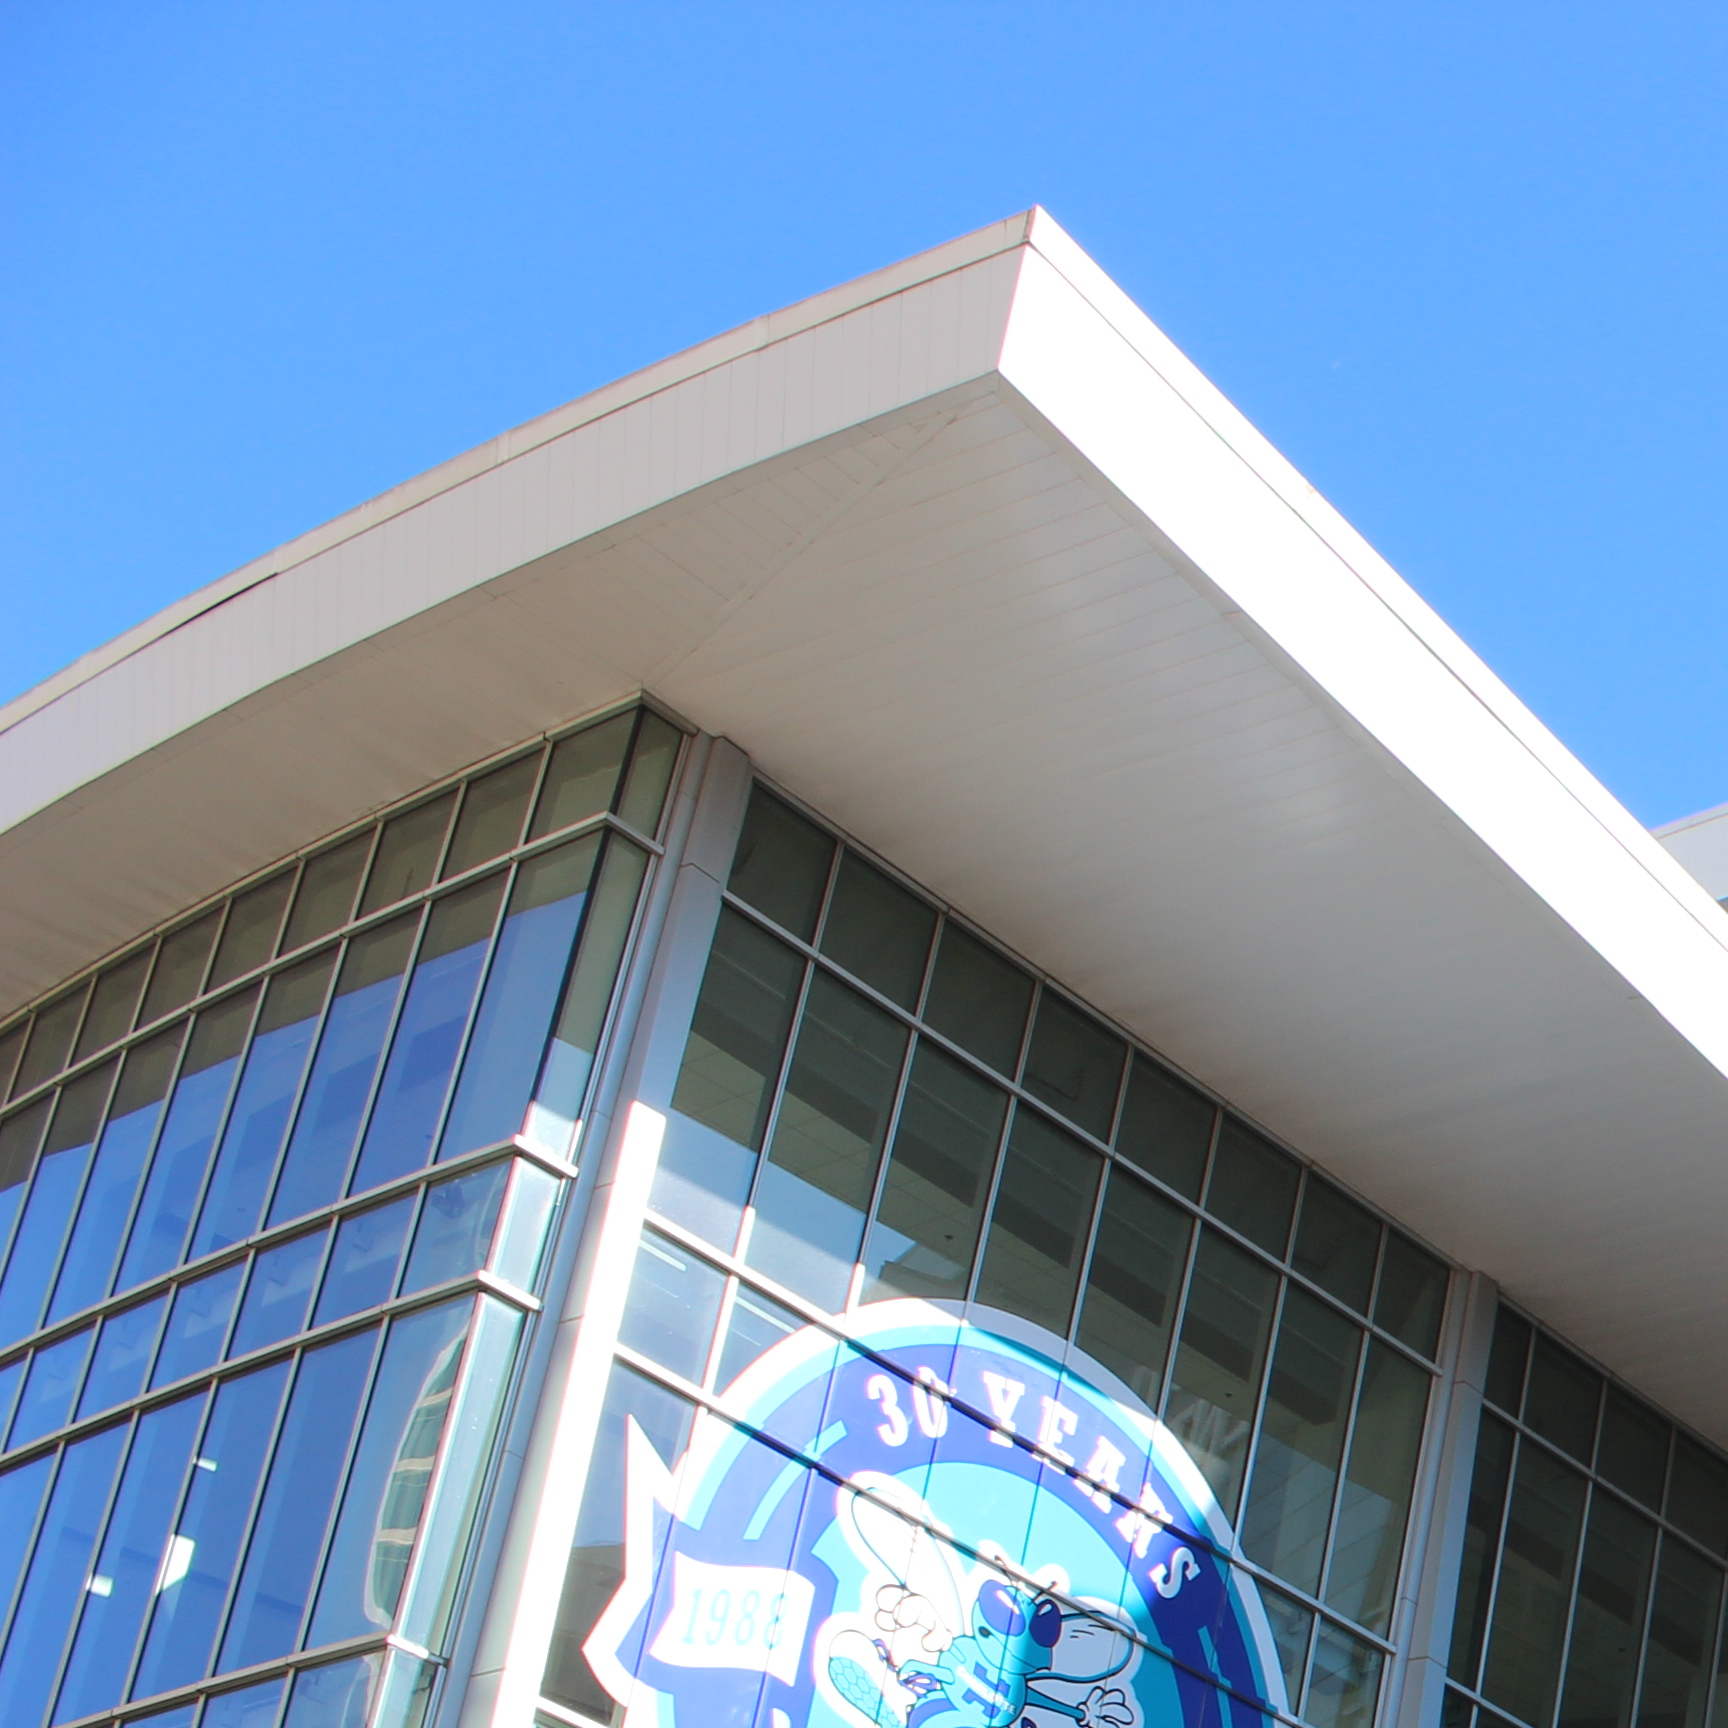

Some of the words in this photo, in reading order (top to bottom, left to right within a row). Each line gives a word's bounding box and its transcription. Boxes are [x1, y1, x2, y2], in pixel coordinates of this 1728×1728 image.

[866, 1365, 952, 1447] 30
[982, 1370, 1200, 1599] YEARS
[682, 1587, 789, 1650] 1988
